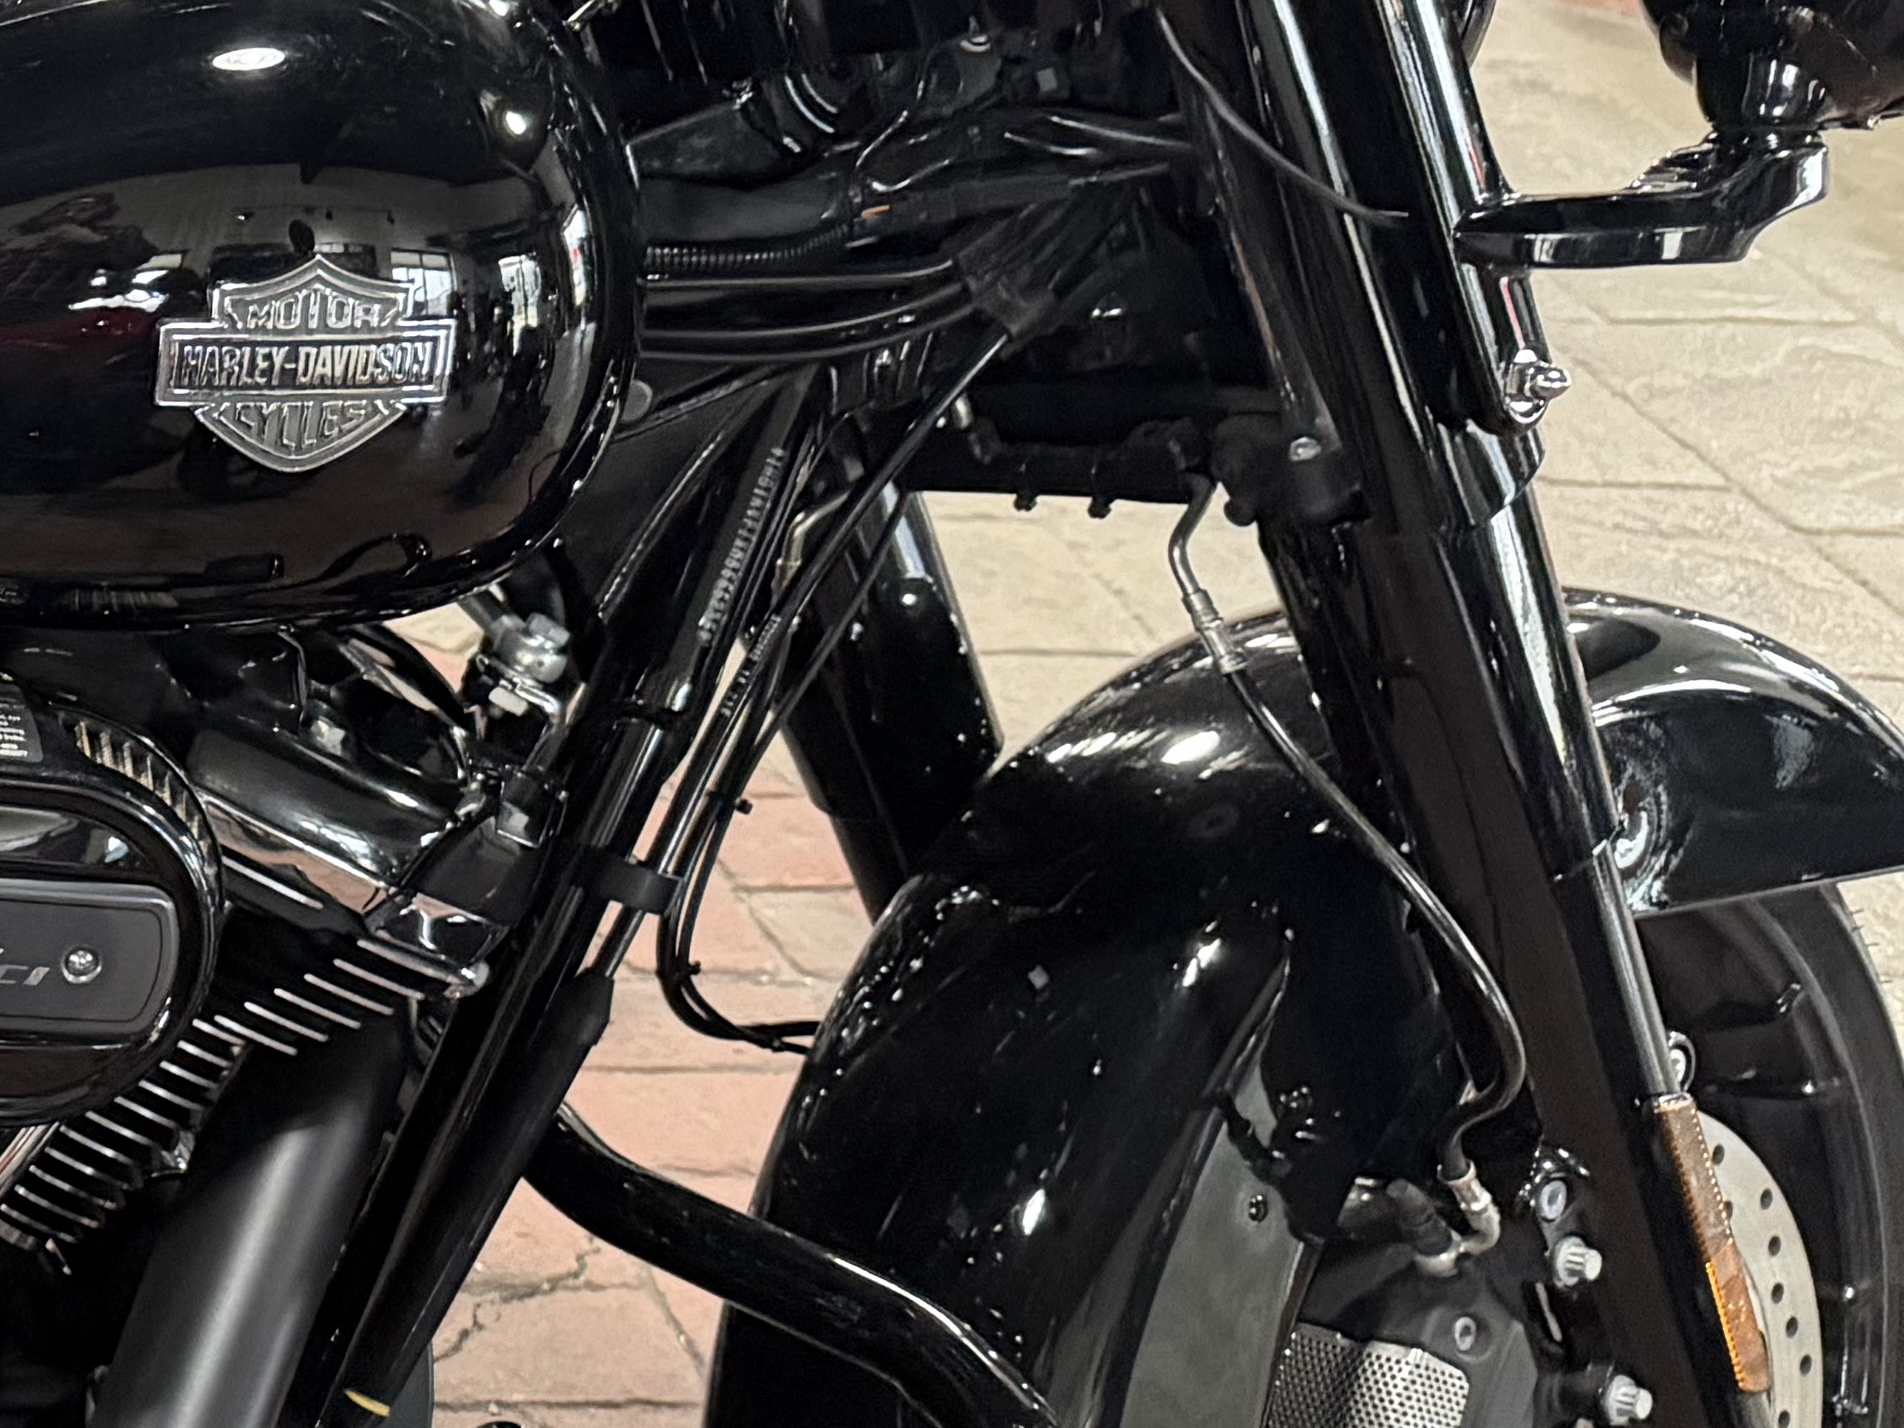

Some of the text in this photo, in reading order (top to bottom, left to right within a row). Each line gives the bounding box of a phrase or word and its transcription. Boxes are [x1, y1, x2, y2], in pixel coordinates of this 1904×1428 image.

[247, 284, 380, 331] MOTOR
[182, 341, 432, 388] HARLEY-DAVIDSON
[235, 400, 370, 448] CYCLES
